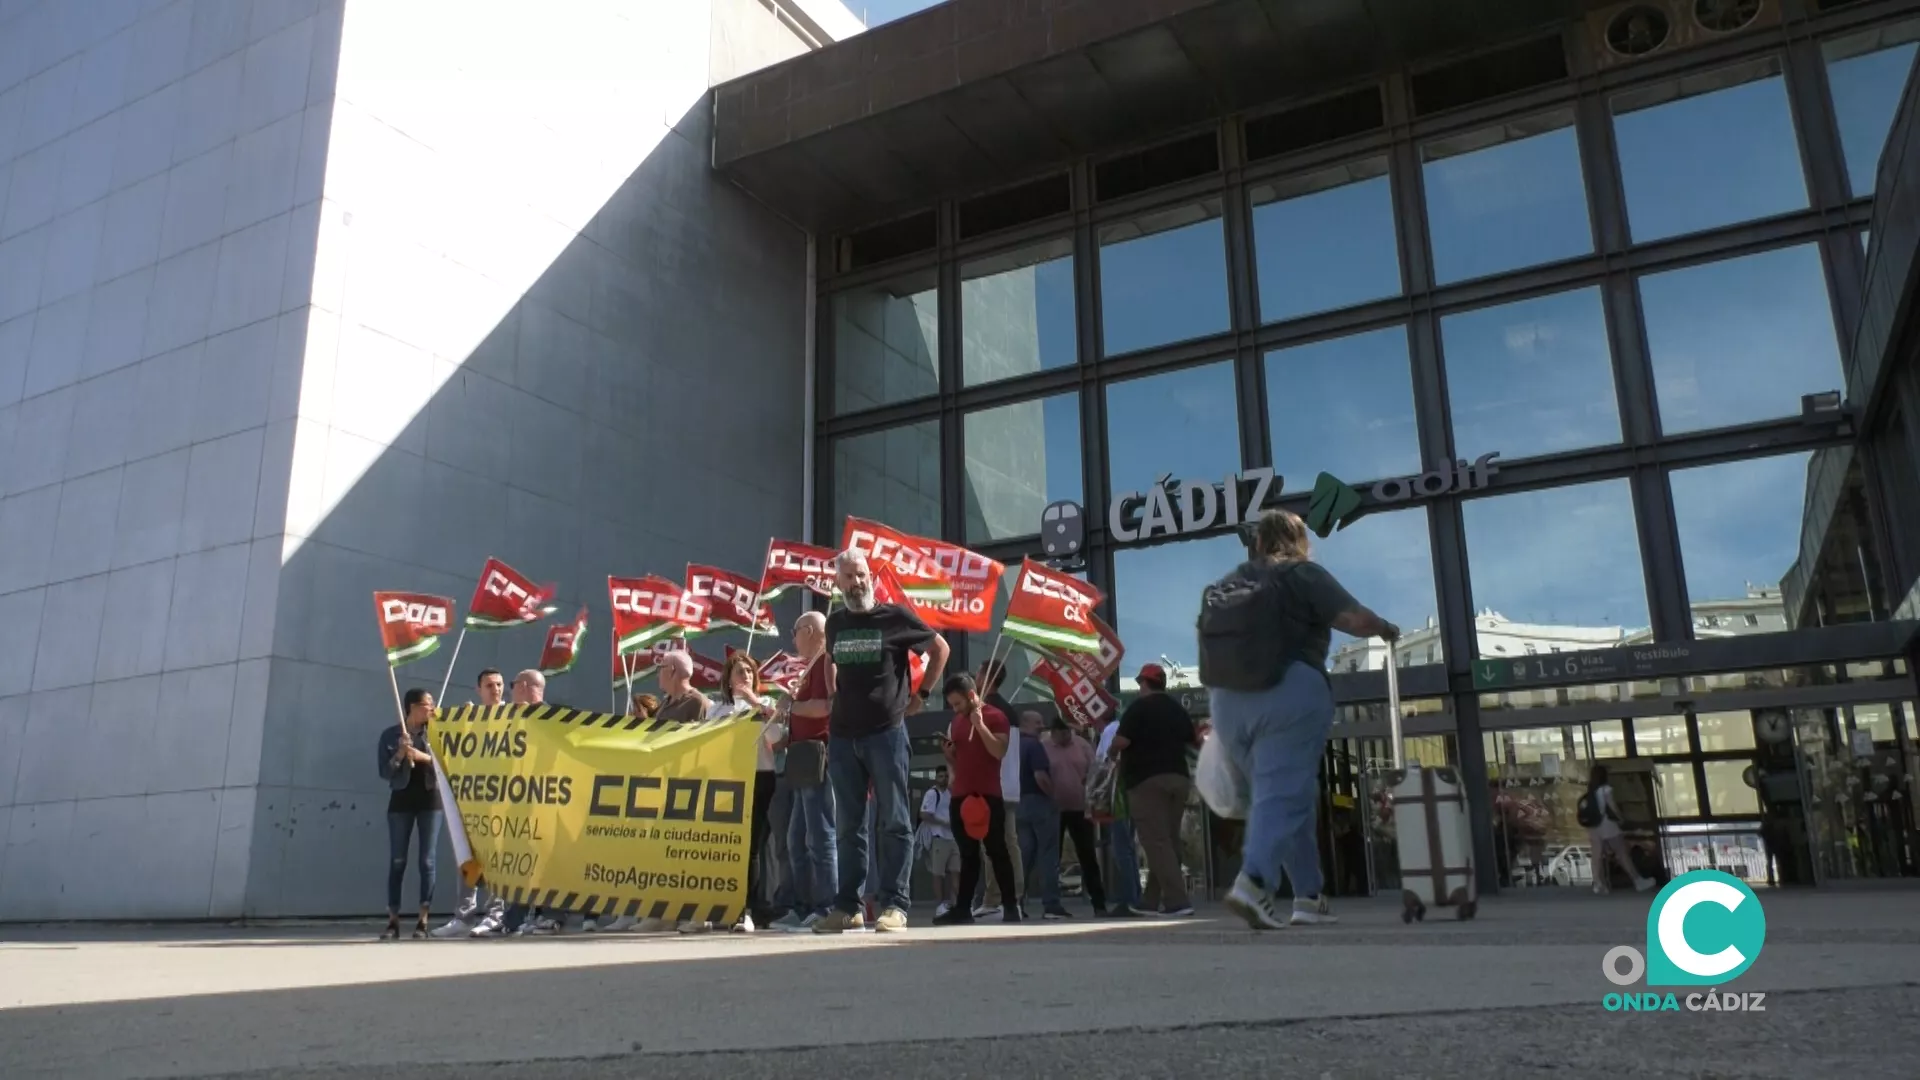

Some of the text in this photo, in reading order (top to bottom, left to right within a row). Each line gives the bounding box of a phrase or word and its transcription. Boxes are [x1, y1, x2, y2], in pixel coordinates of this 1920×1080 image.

[1371, 451, 1500, 502] adif
[1109, 467, 1275, 542] CÁDIZ
[1565, 656, 1578, 675] 6
[480, 723, 527, 758] MÁS
[449, 774, 573, 805] GRESIONES
[589, 775, 745, 824] CCOO
[464, 813, 542, 840] ERSONAL
[586, 825, 742, 846] servicios a la ciudadanía
[665, 845, 741, 863] ferroviario
[584, 863, 739, 893] #StopAgresiones
